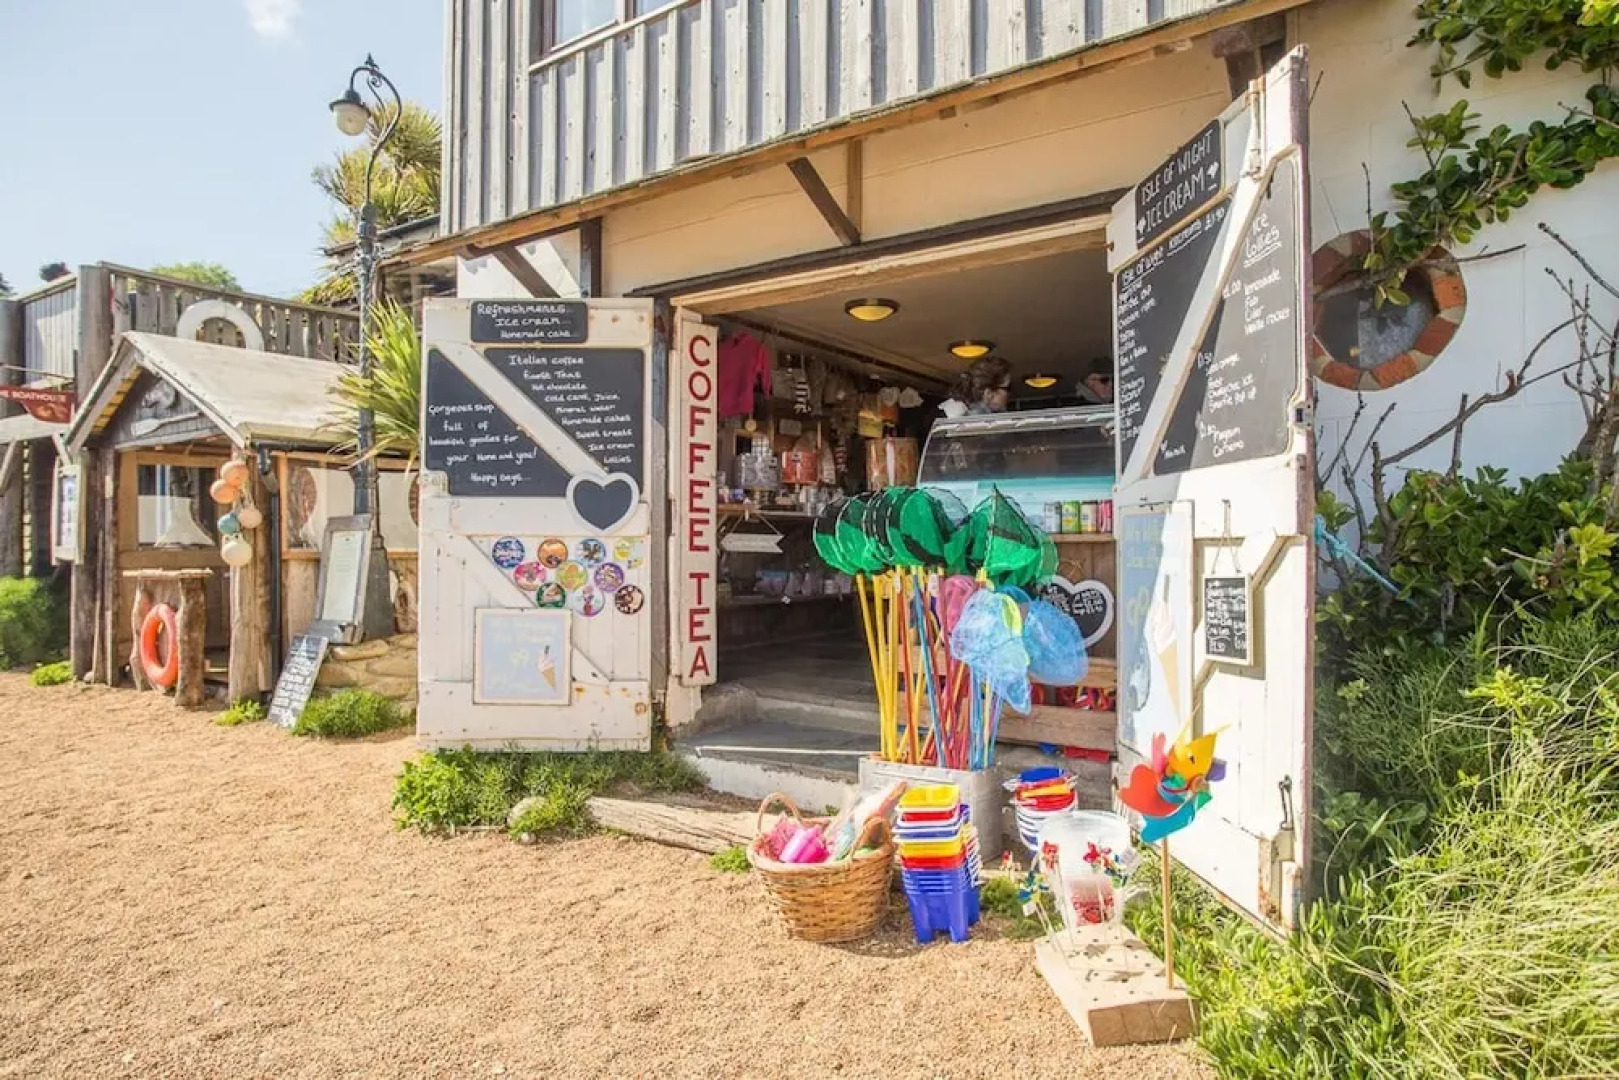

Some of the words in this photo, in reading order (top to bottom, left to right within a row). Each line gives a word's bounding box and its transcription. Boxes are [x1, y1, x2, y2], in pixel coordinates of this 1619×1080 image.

[1142, 174, 1160, 206] ISLE
[1163, 161, 1174, 184] OF
[1177, 129, 1213, 175] WIGHT
[1146, 202, 1163, 232] ICE
[1164, 166, 1205, 219] CREAM
[508, 354, 548, 365] Italian
[477, 421, 489, 432] of
[503, 434, 519, 445] for
[688, 334, 712, 552] COFFEE
[446, 454, 469, 466] your
[498, 450, 514, 460] and
[470, 472, 498, 487] Happy
[688, 572, 712, 678] TEA
